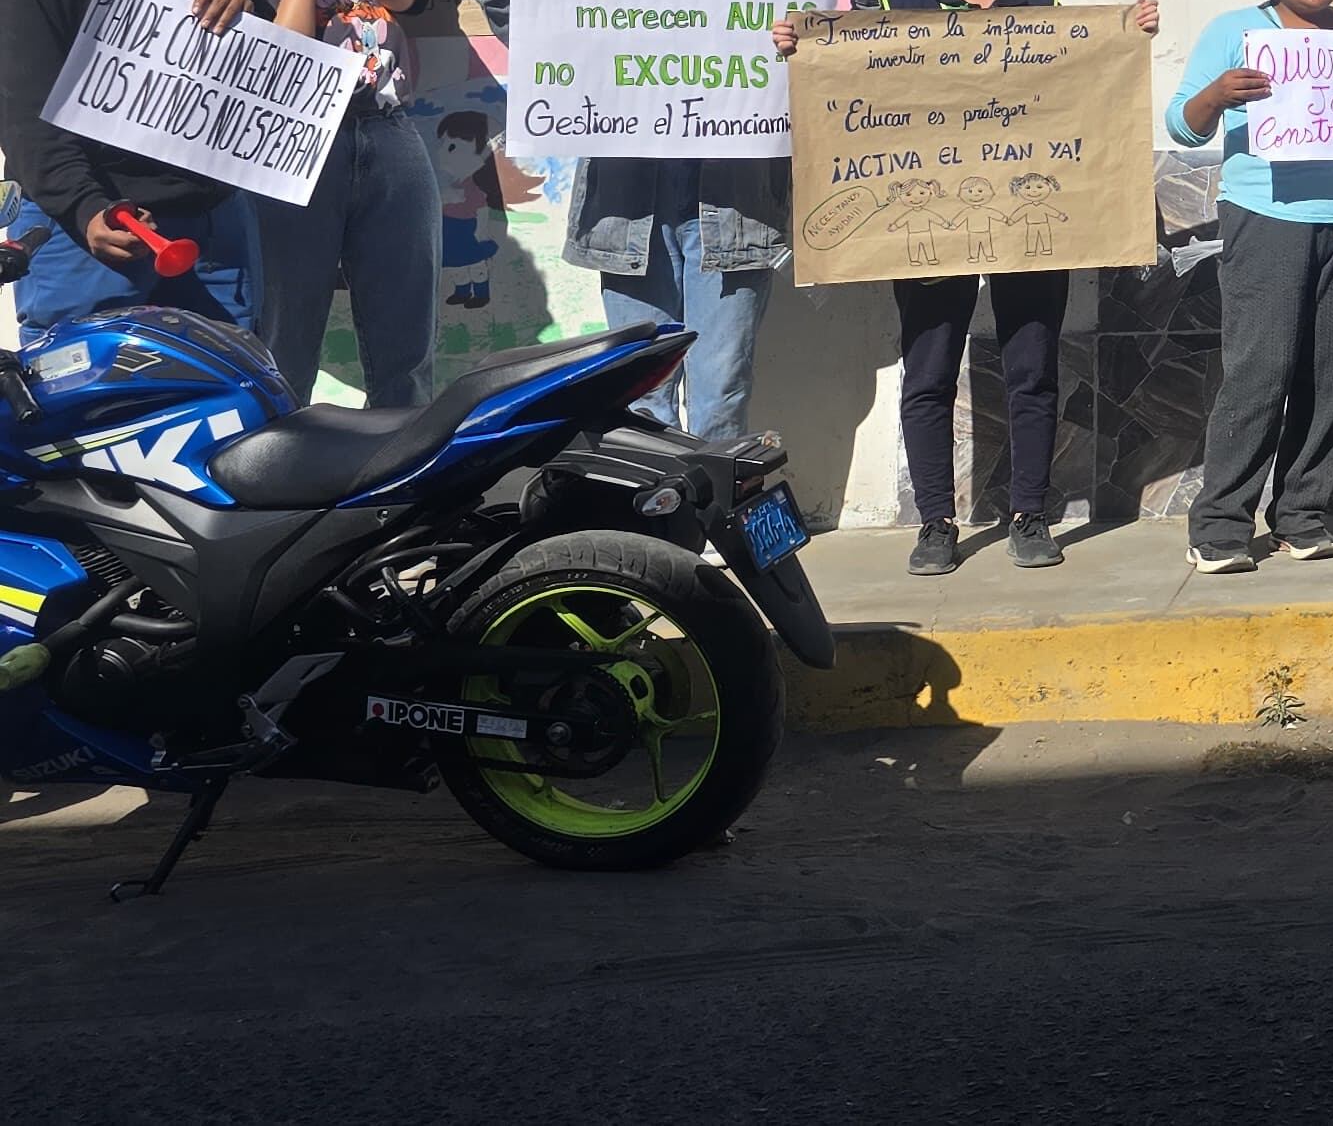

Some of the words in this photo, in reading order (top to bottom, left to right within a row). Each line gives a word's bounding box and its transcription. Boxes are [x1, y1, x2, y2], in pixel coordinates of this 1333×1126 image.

[576, 6, 708, 29] merecen
[907, 26, 931, 37] en
[946, 12, 965, 37] la
[982, 15, 1056, 45] infancia
[1070, 25, 1089, 40] es
[129, 0, 173, 58] DE
[165, 15, 313, 109] CONTINGENCIA
[866, 46, 925, 70] invertir
[940, 51, 961, 65] en
[974, 44, 991, 65] el
[535, 61, 575, 86] no
[78, 51, 136, 113] LOS
[127, 69, 218, 140] NIÑOS
[232, 105, 331, 180] ESPERAN
[524, 95, 638, 136] Gestione
[654, 103, 672, 135] el
[928, 112, 945, 125] es
[831, 153, 923, 184] ¡ACTIVA
[938, 146, 963, 165] EL
[982, 142, 1033, 162] PLAN
[1048, 138, 1082, 162] YA!
[389, 702, 463, 732] IPONE
